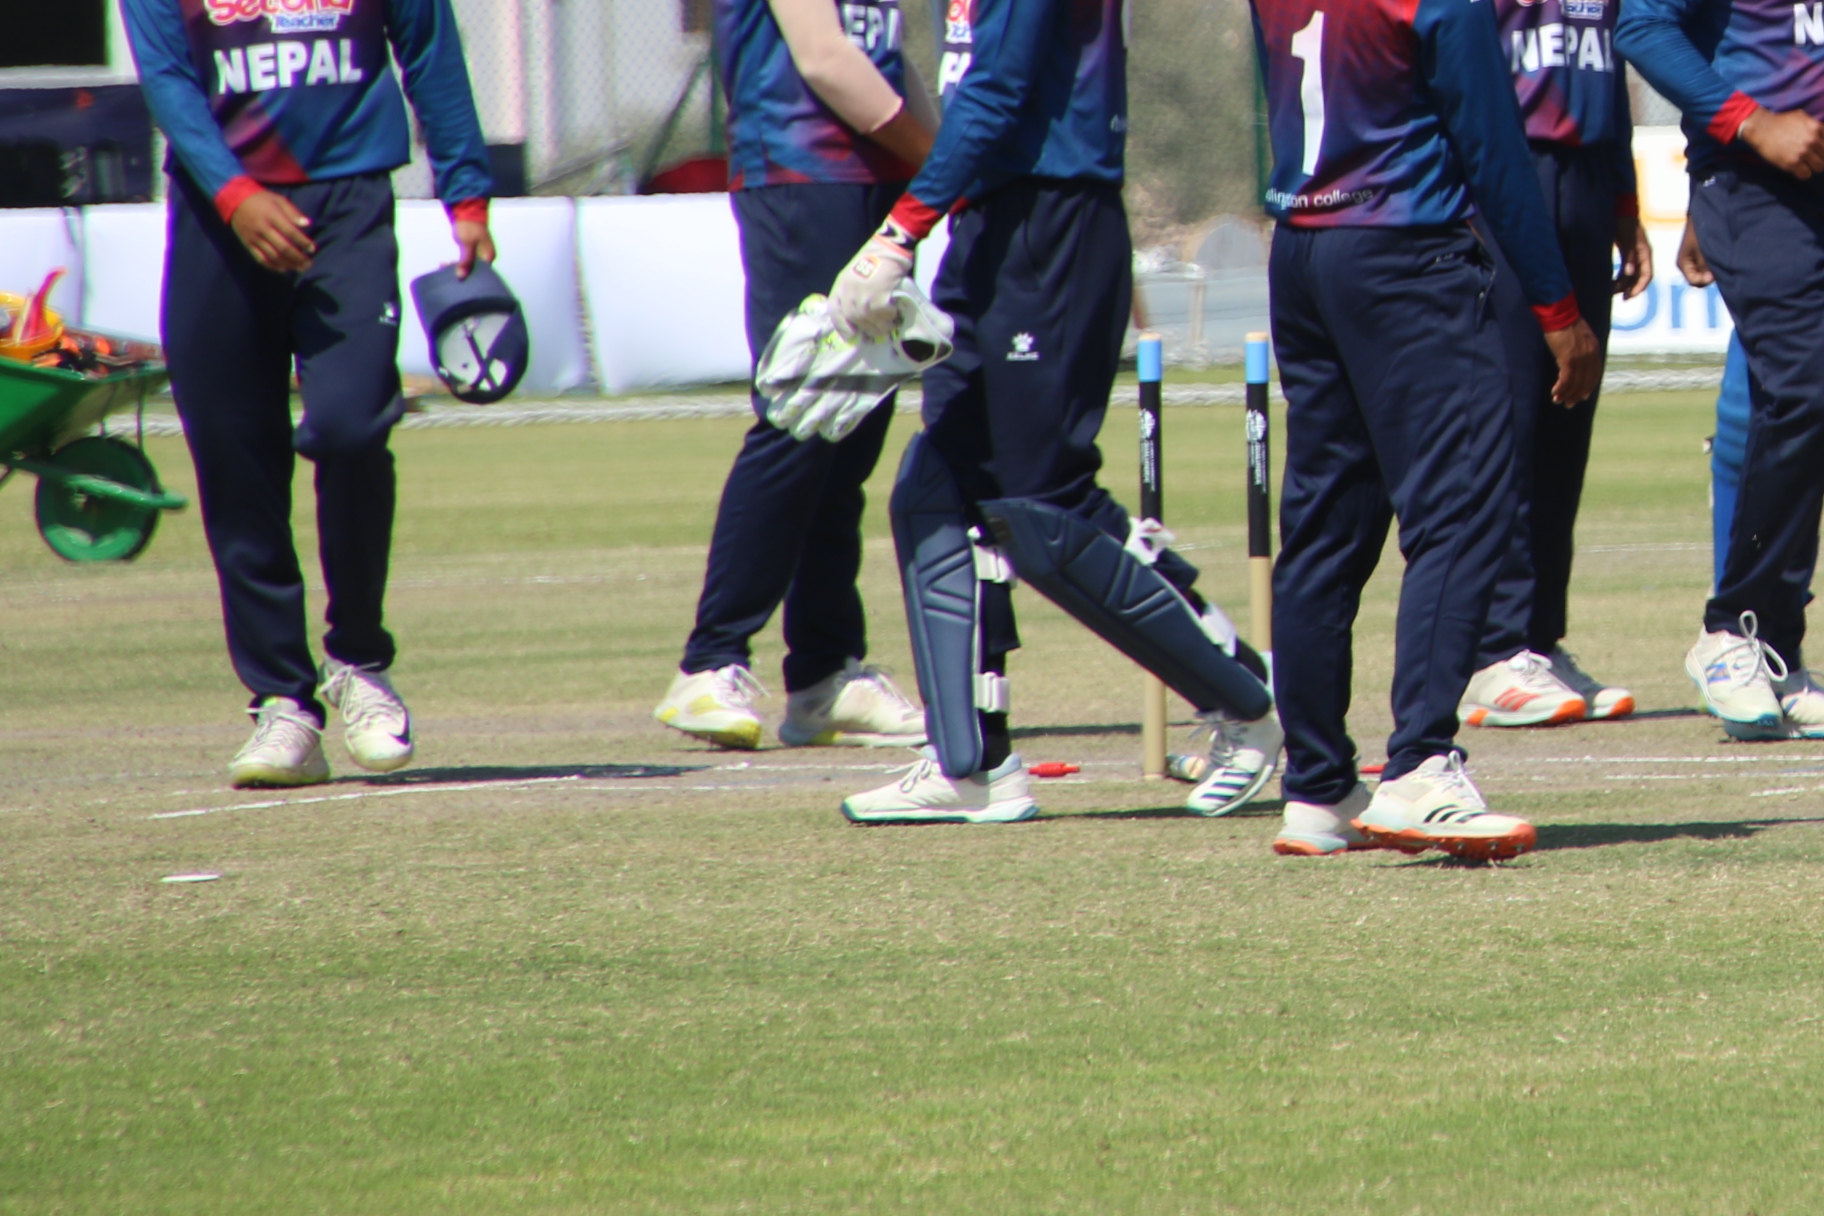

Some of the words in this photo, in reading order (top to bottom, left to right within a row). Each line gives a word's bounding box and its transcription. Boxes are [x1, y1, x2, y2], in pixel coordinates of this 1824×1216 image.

[213, 38, 364, 95] NEPAL
[1510, 23, 1614, 73] NEPAL
[1291, 10, 1325, 176] 1
